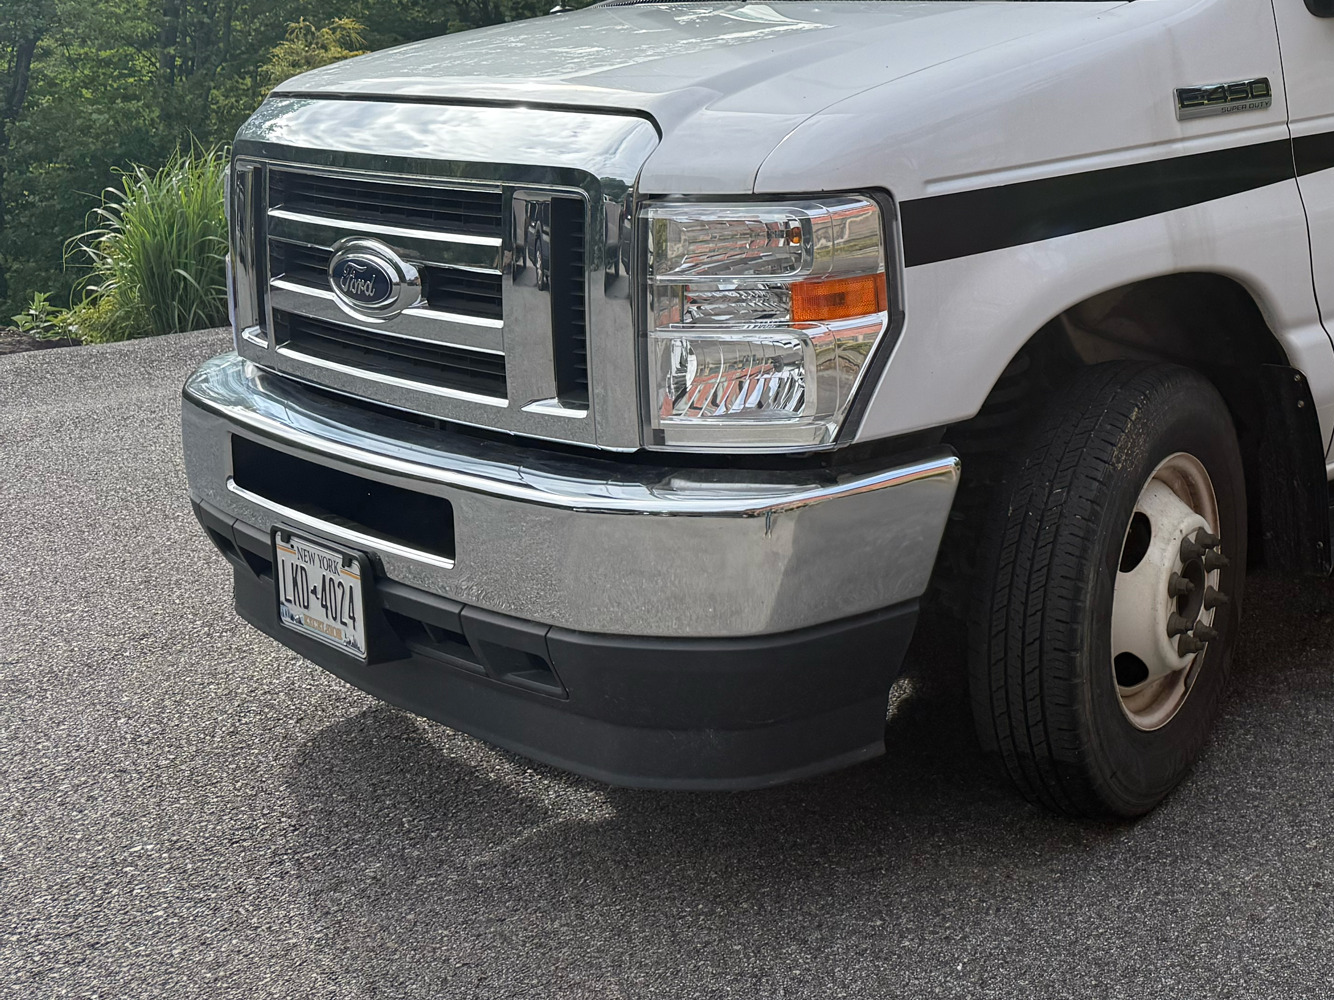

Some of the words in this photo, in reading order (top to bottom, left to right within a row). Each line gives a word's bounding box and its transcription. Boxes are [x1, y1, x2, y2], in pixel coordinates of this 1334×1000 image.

[1221, 105, 1247, 113] SUPER
[1248, 101, 1270, 109] DUTY
[340, 261, 376, 297] Ford
[296, 546, 316, 567] NEW
[317, 554, 341, 577] YORK
